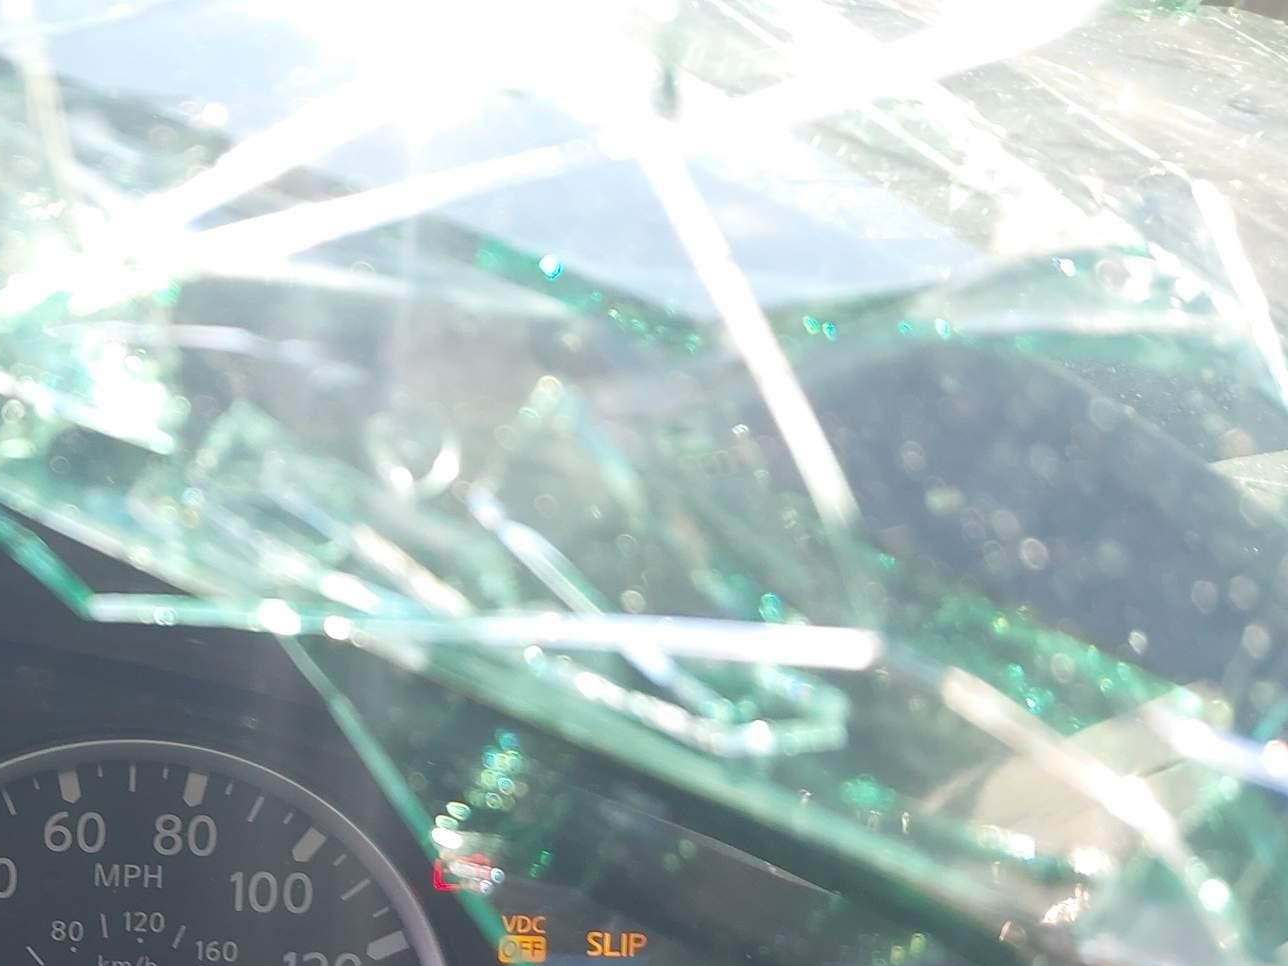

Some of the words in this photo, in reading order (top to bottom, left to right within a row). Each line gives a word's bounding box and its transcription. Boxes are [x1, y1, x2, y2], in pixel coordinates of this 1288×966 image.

[43, 811, 106, 853] 60
[153, 815, 217, 857] 80
[93, 864, 164, 888] MPH
[231, 872, 312, 914] 100
[51, 920, 83, 942] 80
[123, 911, 165, 933] 120
[501, 915, 546, 934] VDC
[196, 940, 238, 962] 160
[586, 930, 647, 958] SLIP
